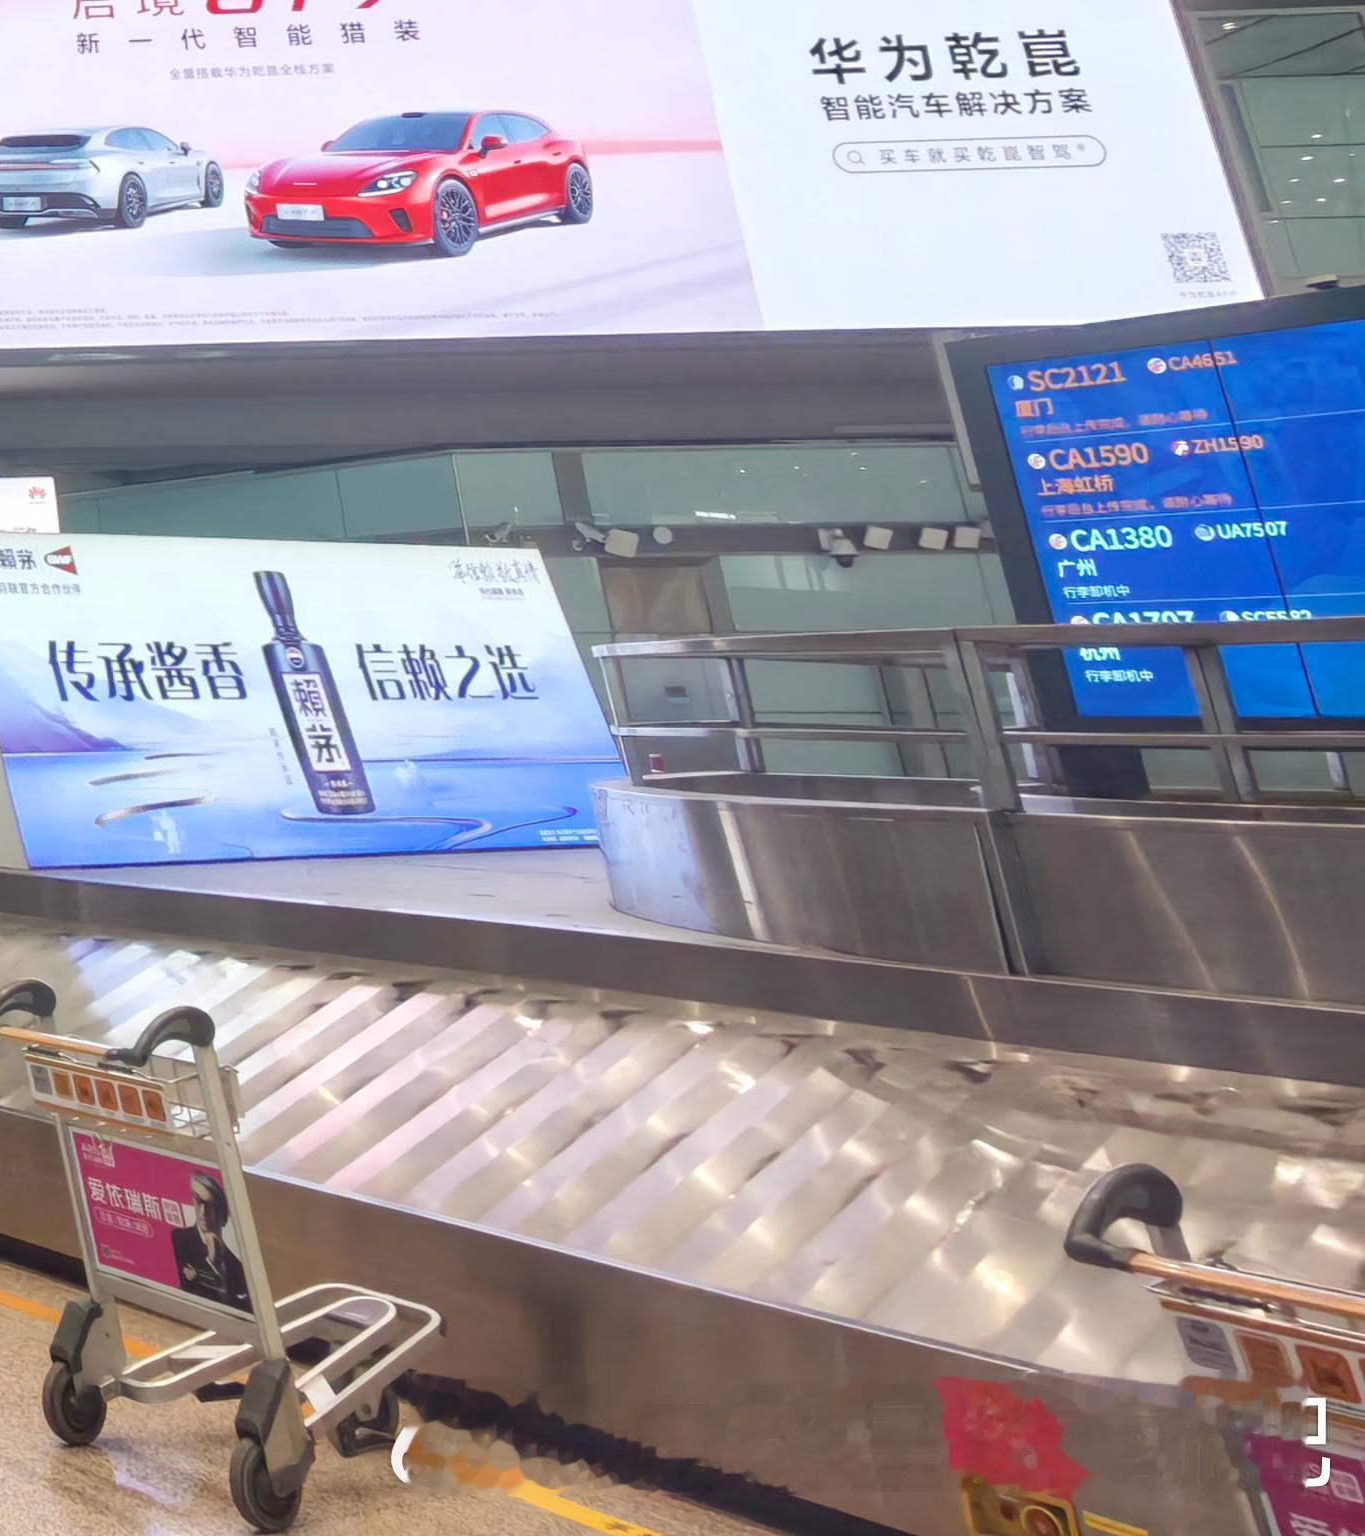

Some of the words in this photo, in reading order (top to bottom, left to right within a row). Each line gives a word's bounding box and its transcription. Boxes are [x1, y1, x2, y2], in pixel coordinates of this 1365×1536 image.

[76, 19, 421, 55] 新一代智能猎装
[809, 28, 1081, 84] 华为乾崑
[820, 88, 1093, 122] 智能汽车解决方案
[1028, 362, 1127, 392] SC2121
[1169, 351, 1237, 371] CA4651
[1048, 442, 1150, 471] CA1590
[1193, 436, 1264, 455] ZH1590
[1037, 474, 1115, 497] 上海虹桥
[1070, 525, 1173, 552] CA1380
[1217, 520, 1288, 540] UA7507
[1057, 558, 1098, 577] 广州
[47, 639, 248, 703] 传承酱香
[354, 642, 541, 702] 信赖之选
[87, 1176, 163, 1221] 爱依瑞斯
